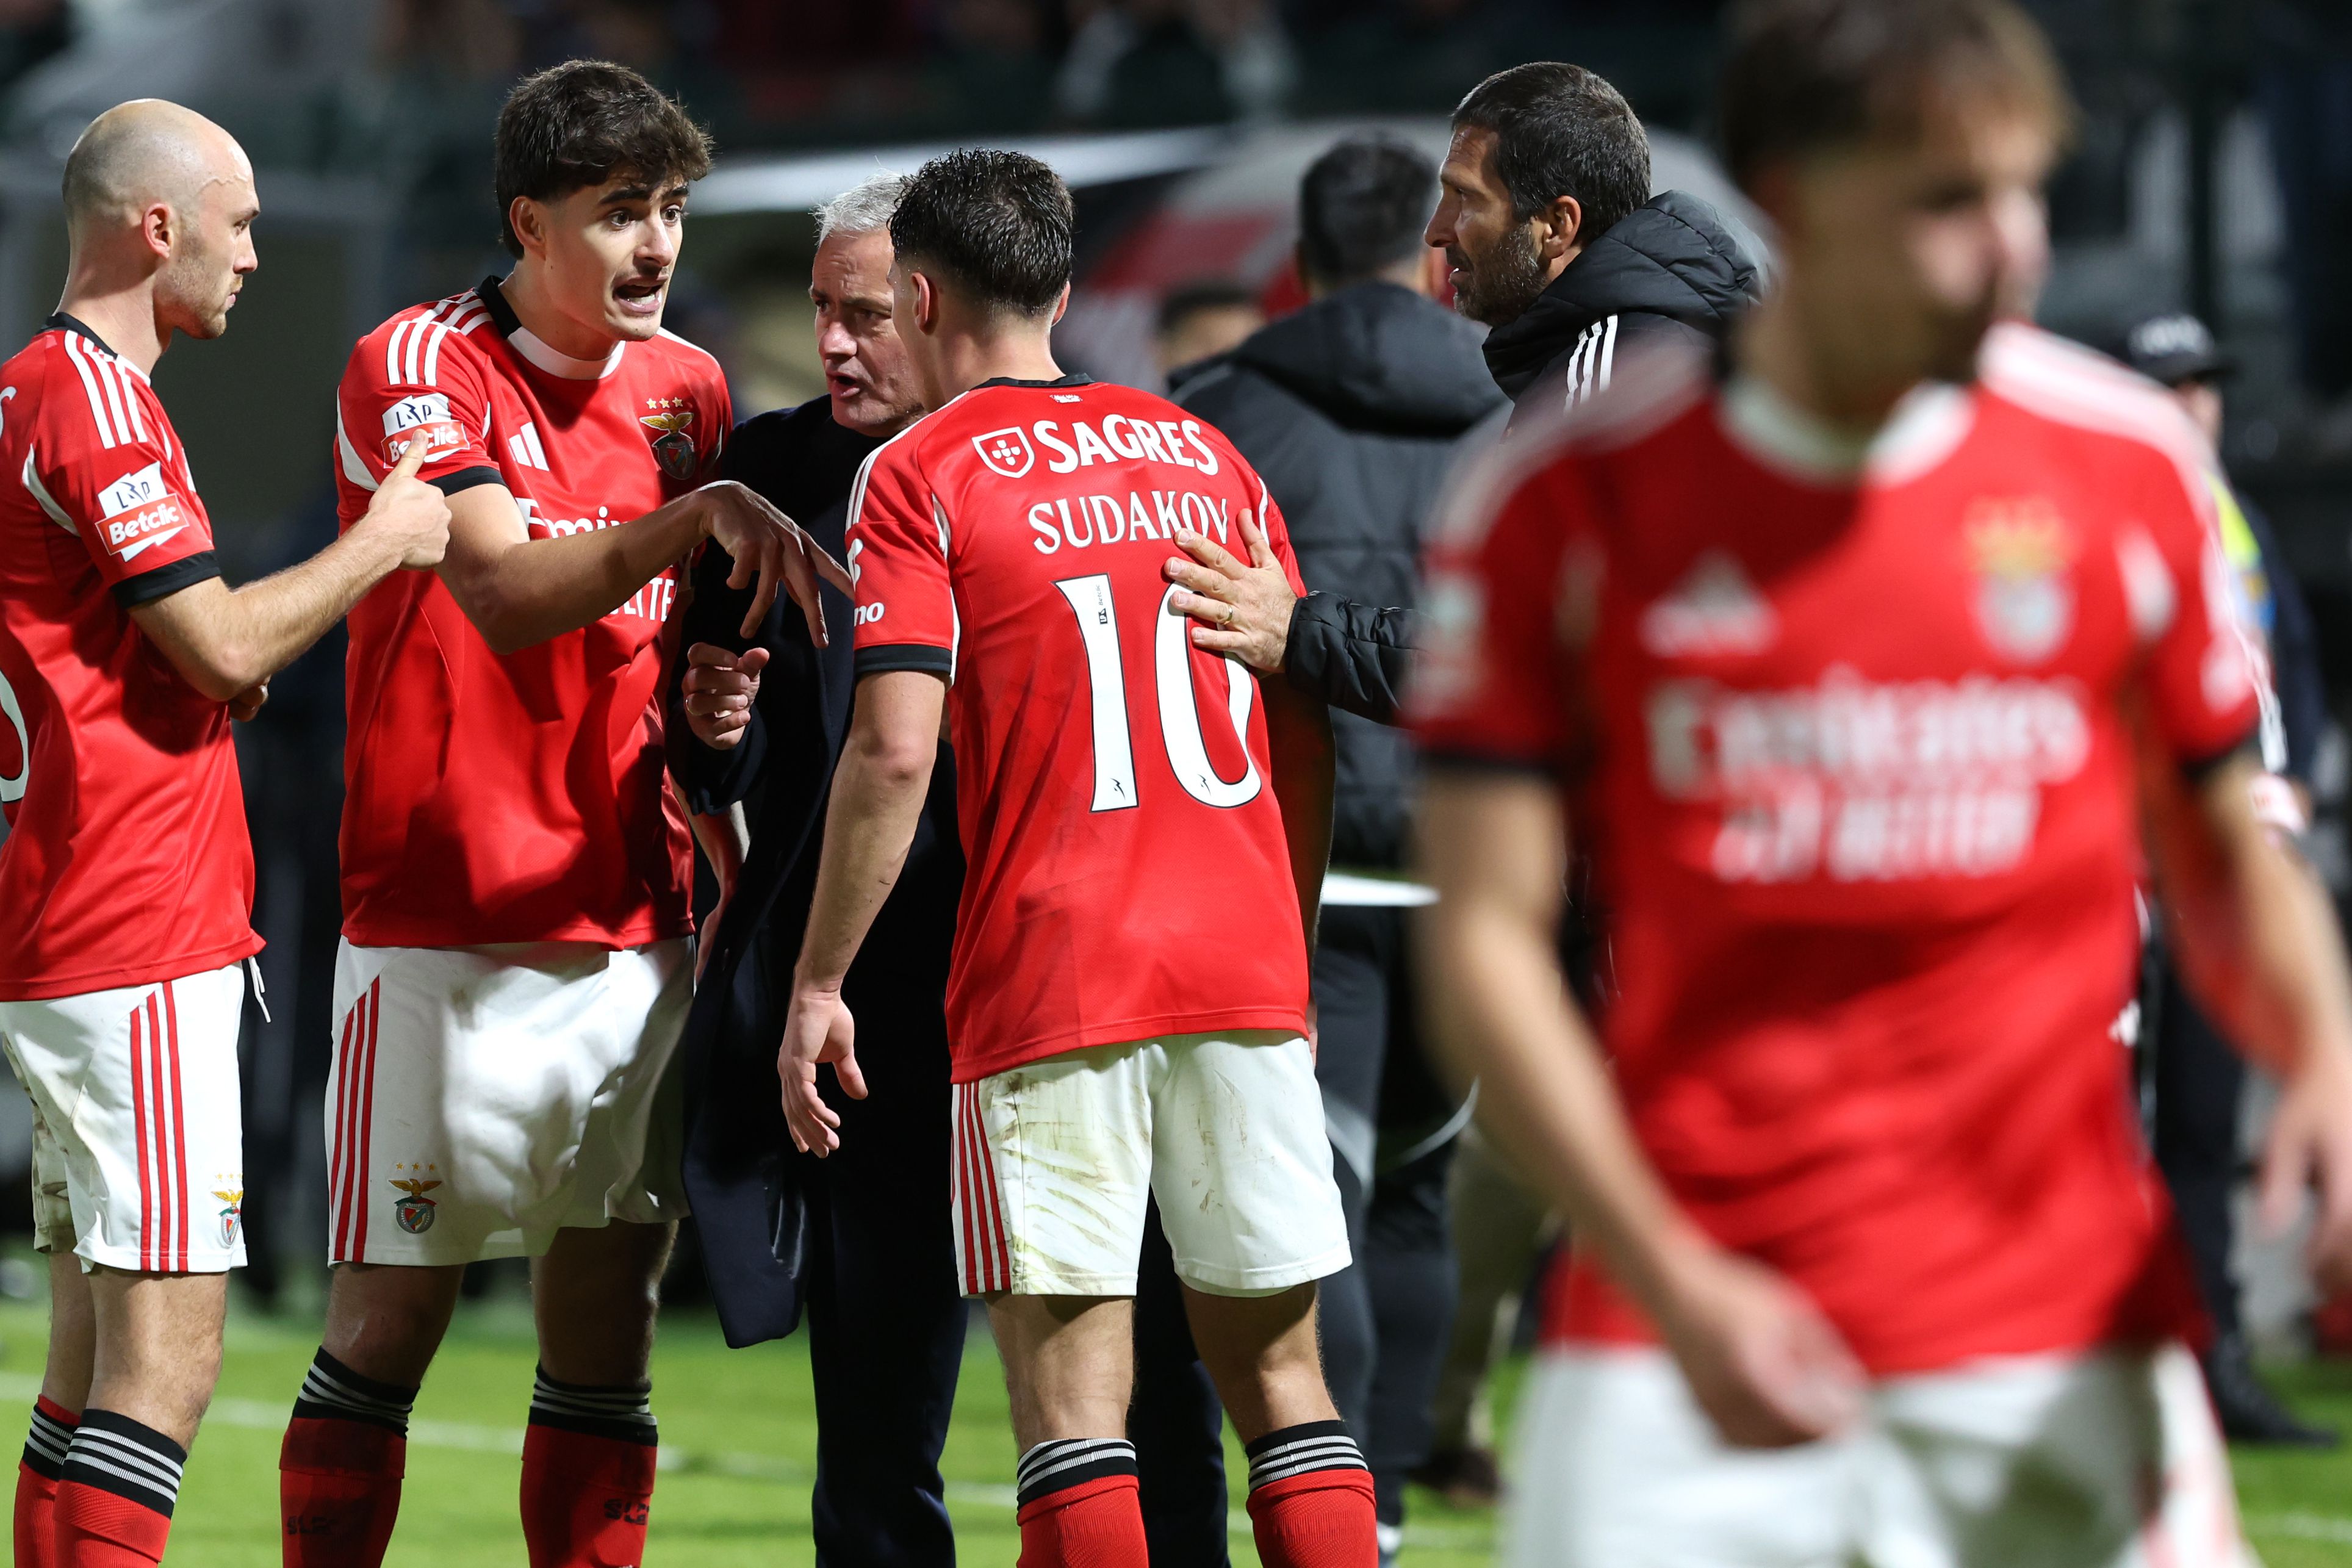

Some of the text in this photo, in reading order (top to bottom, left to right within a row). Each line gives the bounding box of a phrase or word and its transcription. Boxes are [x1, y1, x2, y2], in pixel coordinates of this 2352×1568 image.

[1033, 414, 1219, 476] SAGRES
[108, 503, 179, 545] Betclic
[1028, 491, 1228, 555] SUDAKOV
[1051, 572, 1262, 813] 10
